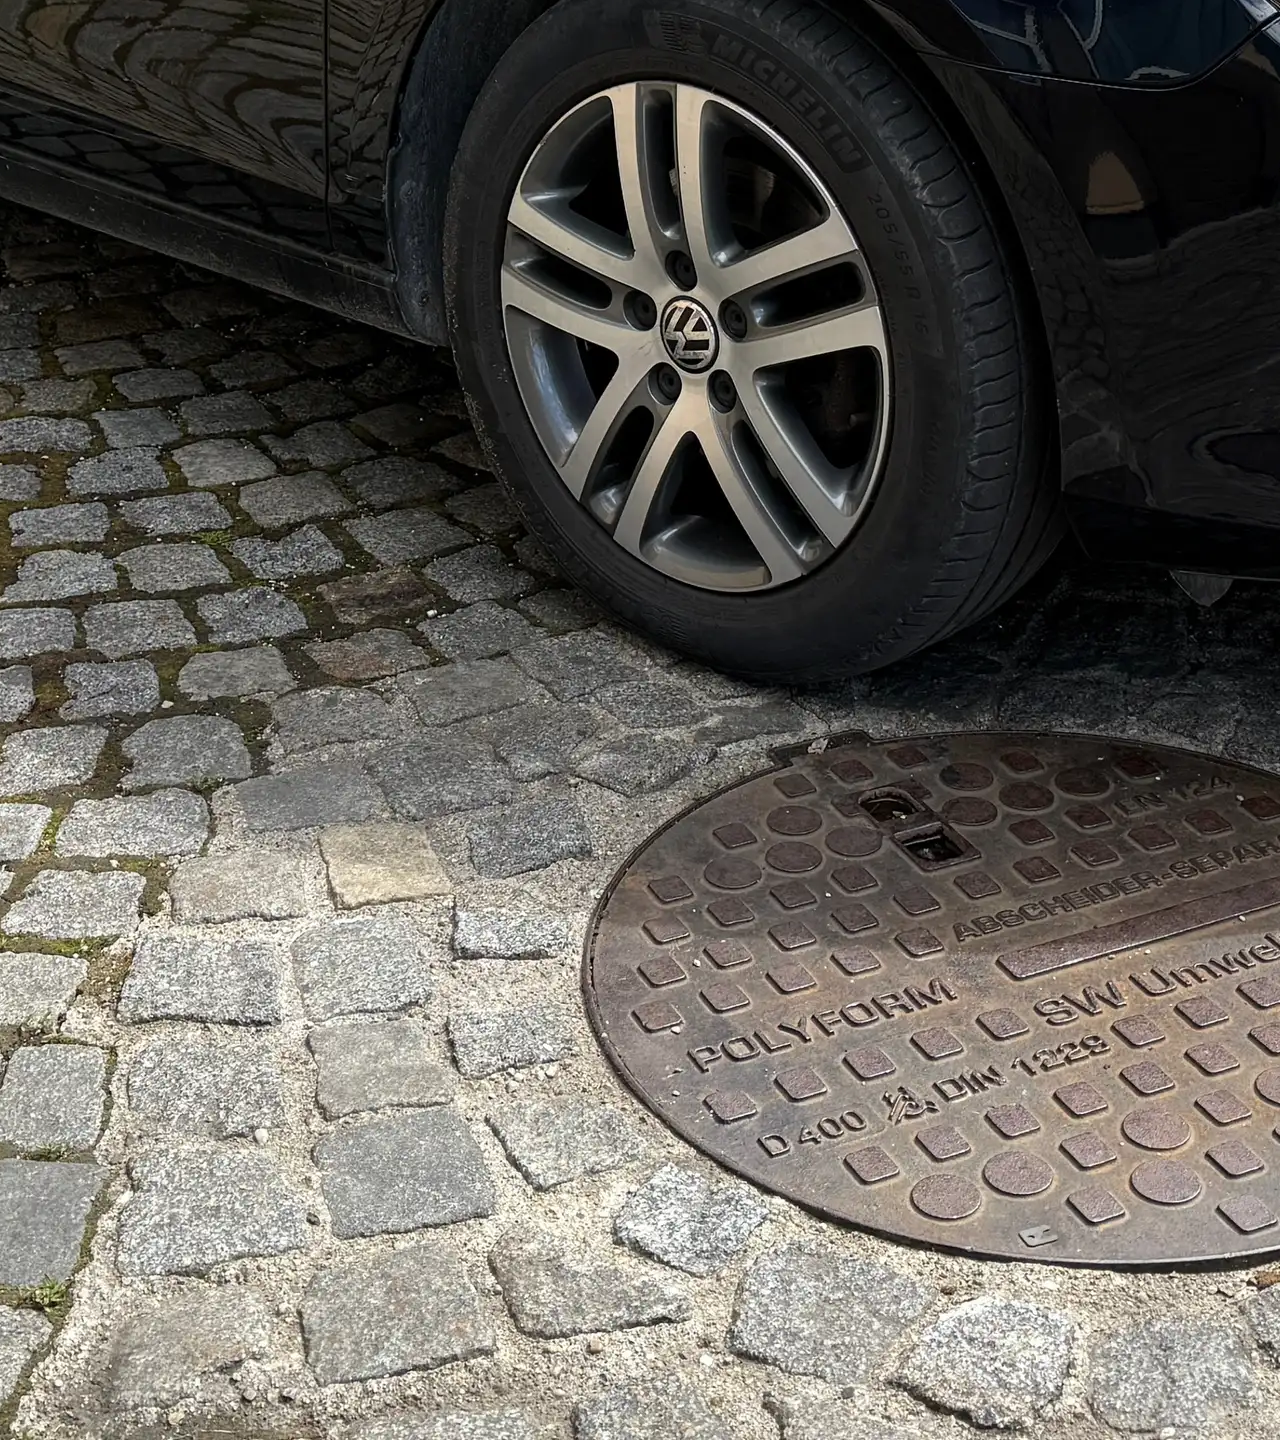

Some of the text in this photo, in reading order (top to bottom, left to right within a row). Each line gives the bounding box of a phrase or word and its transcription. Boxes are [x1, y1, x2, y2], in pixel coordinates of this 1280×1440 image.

[710, 32, 861, 163] MICHELIN
[867, 192, 914, 278] 205/55
[686, 977, 958, 1074] POLYFORM
[1033, 980, 1128, 1027] SW
[757, 1133, 791, 1159] D
[798, 1109, 868, 1148] 400
[932, 1064, 1009, 1103] DIN
